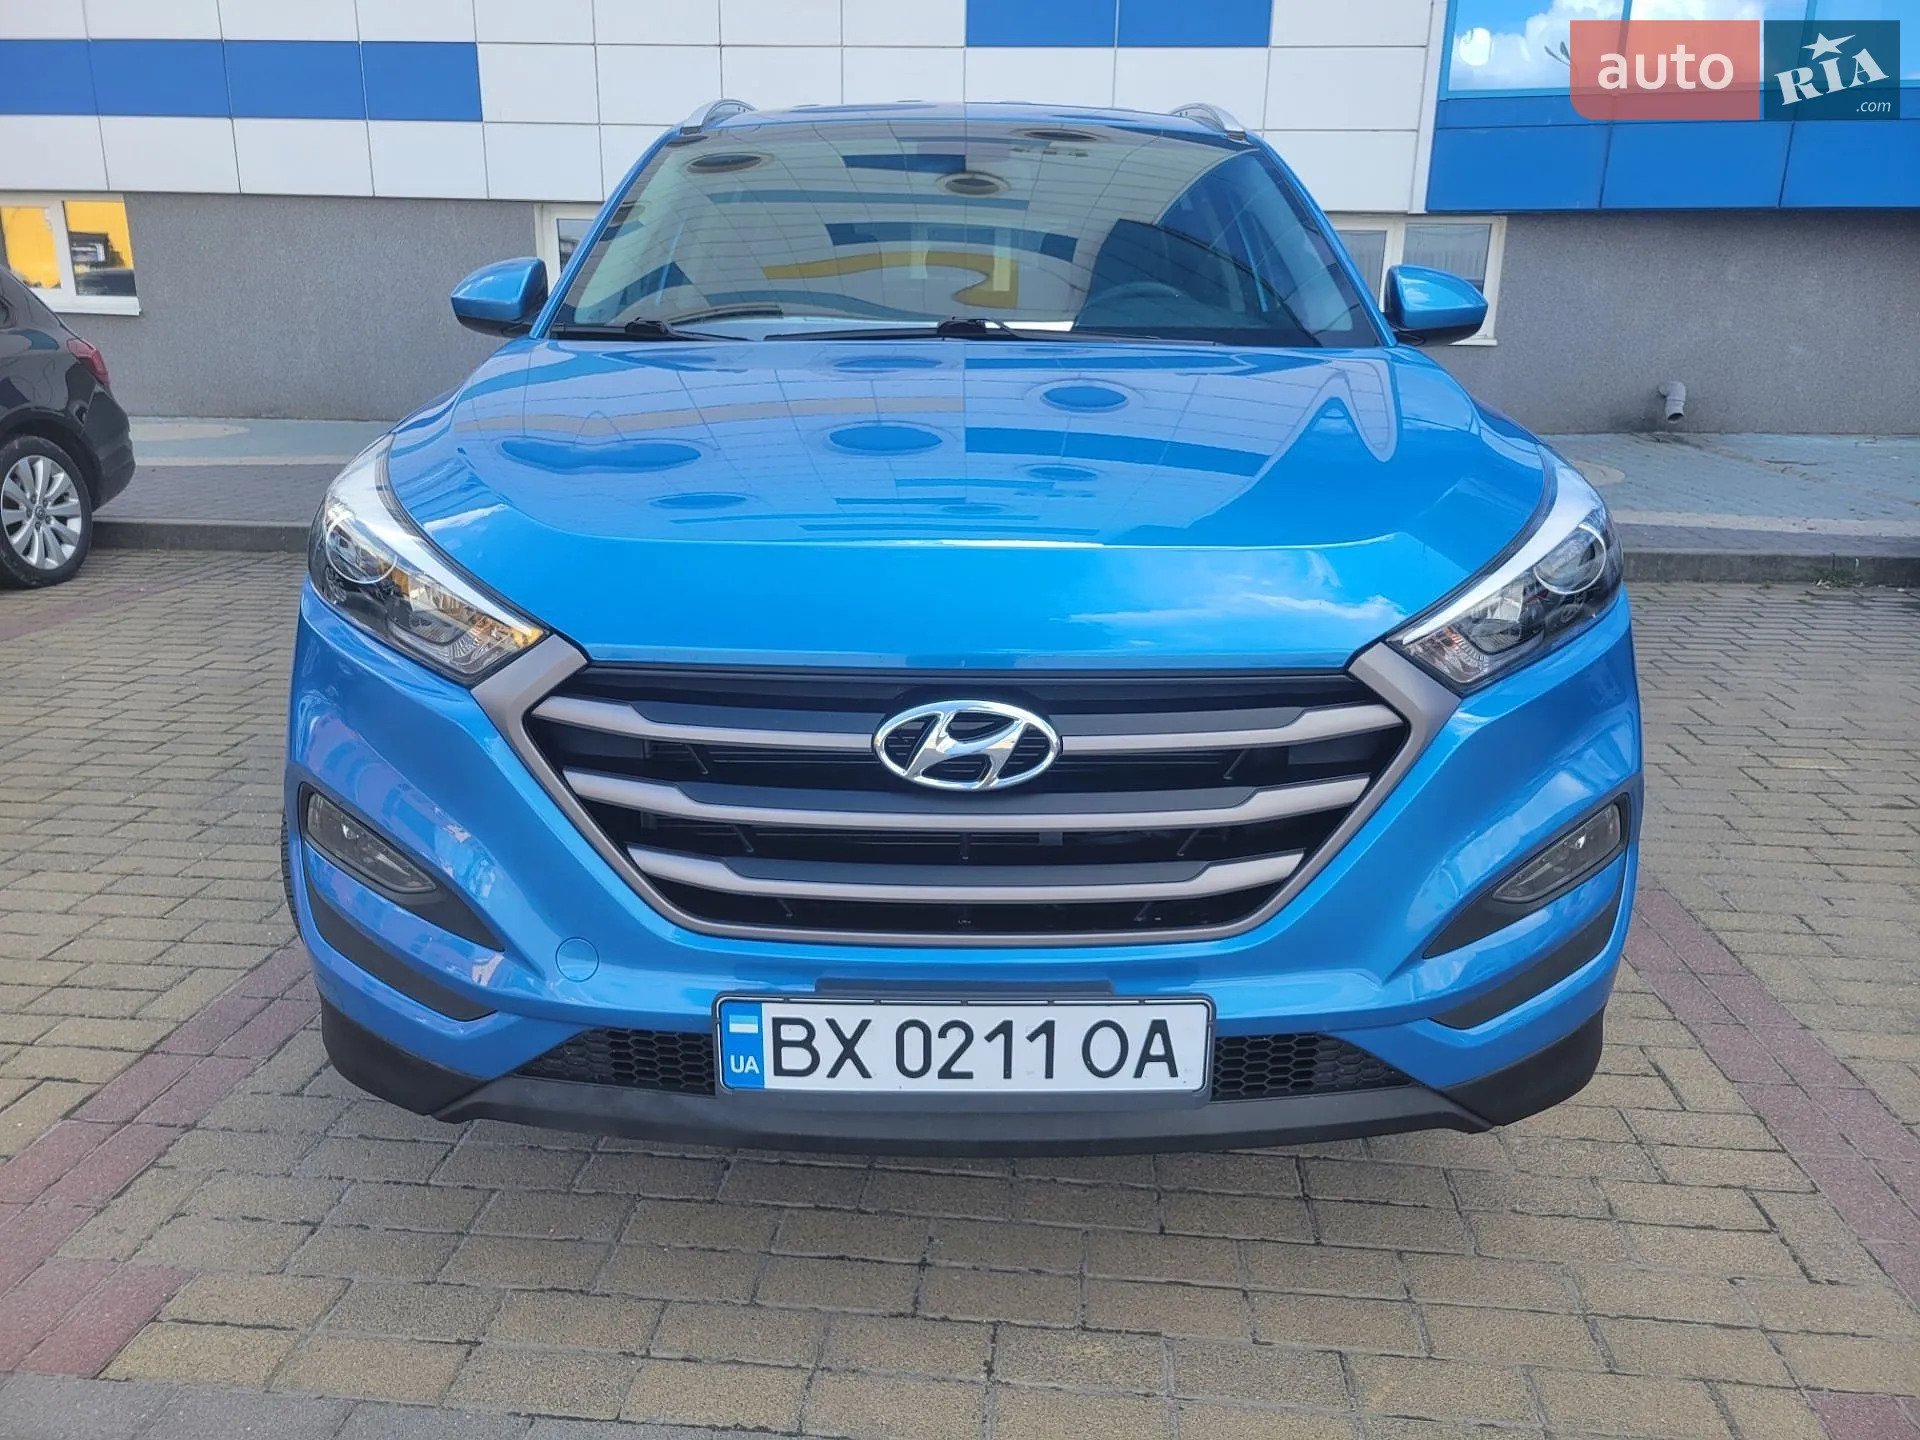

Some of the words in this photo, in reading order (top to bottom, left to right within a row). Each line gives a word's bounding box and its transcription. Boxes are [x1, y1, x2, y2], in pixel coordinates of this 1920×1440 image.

[729, 1055, 760, 1075] UA
[771, 1016, 872, 1079] BX
[895, 1018, 1056, 1079] 0211
[1081, 1018, 1179, 1078] OA
